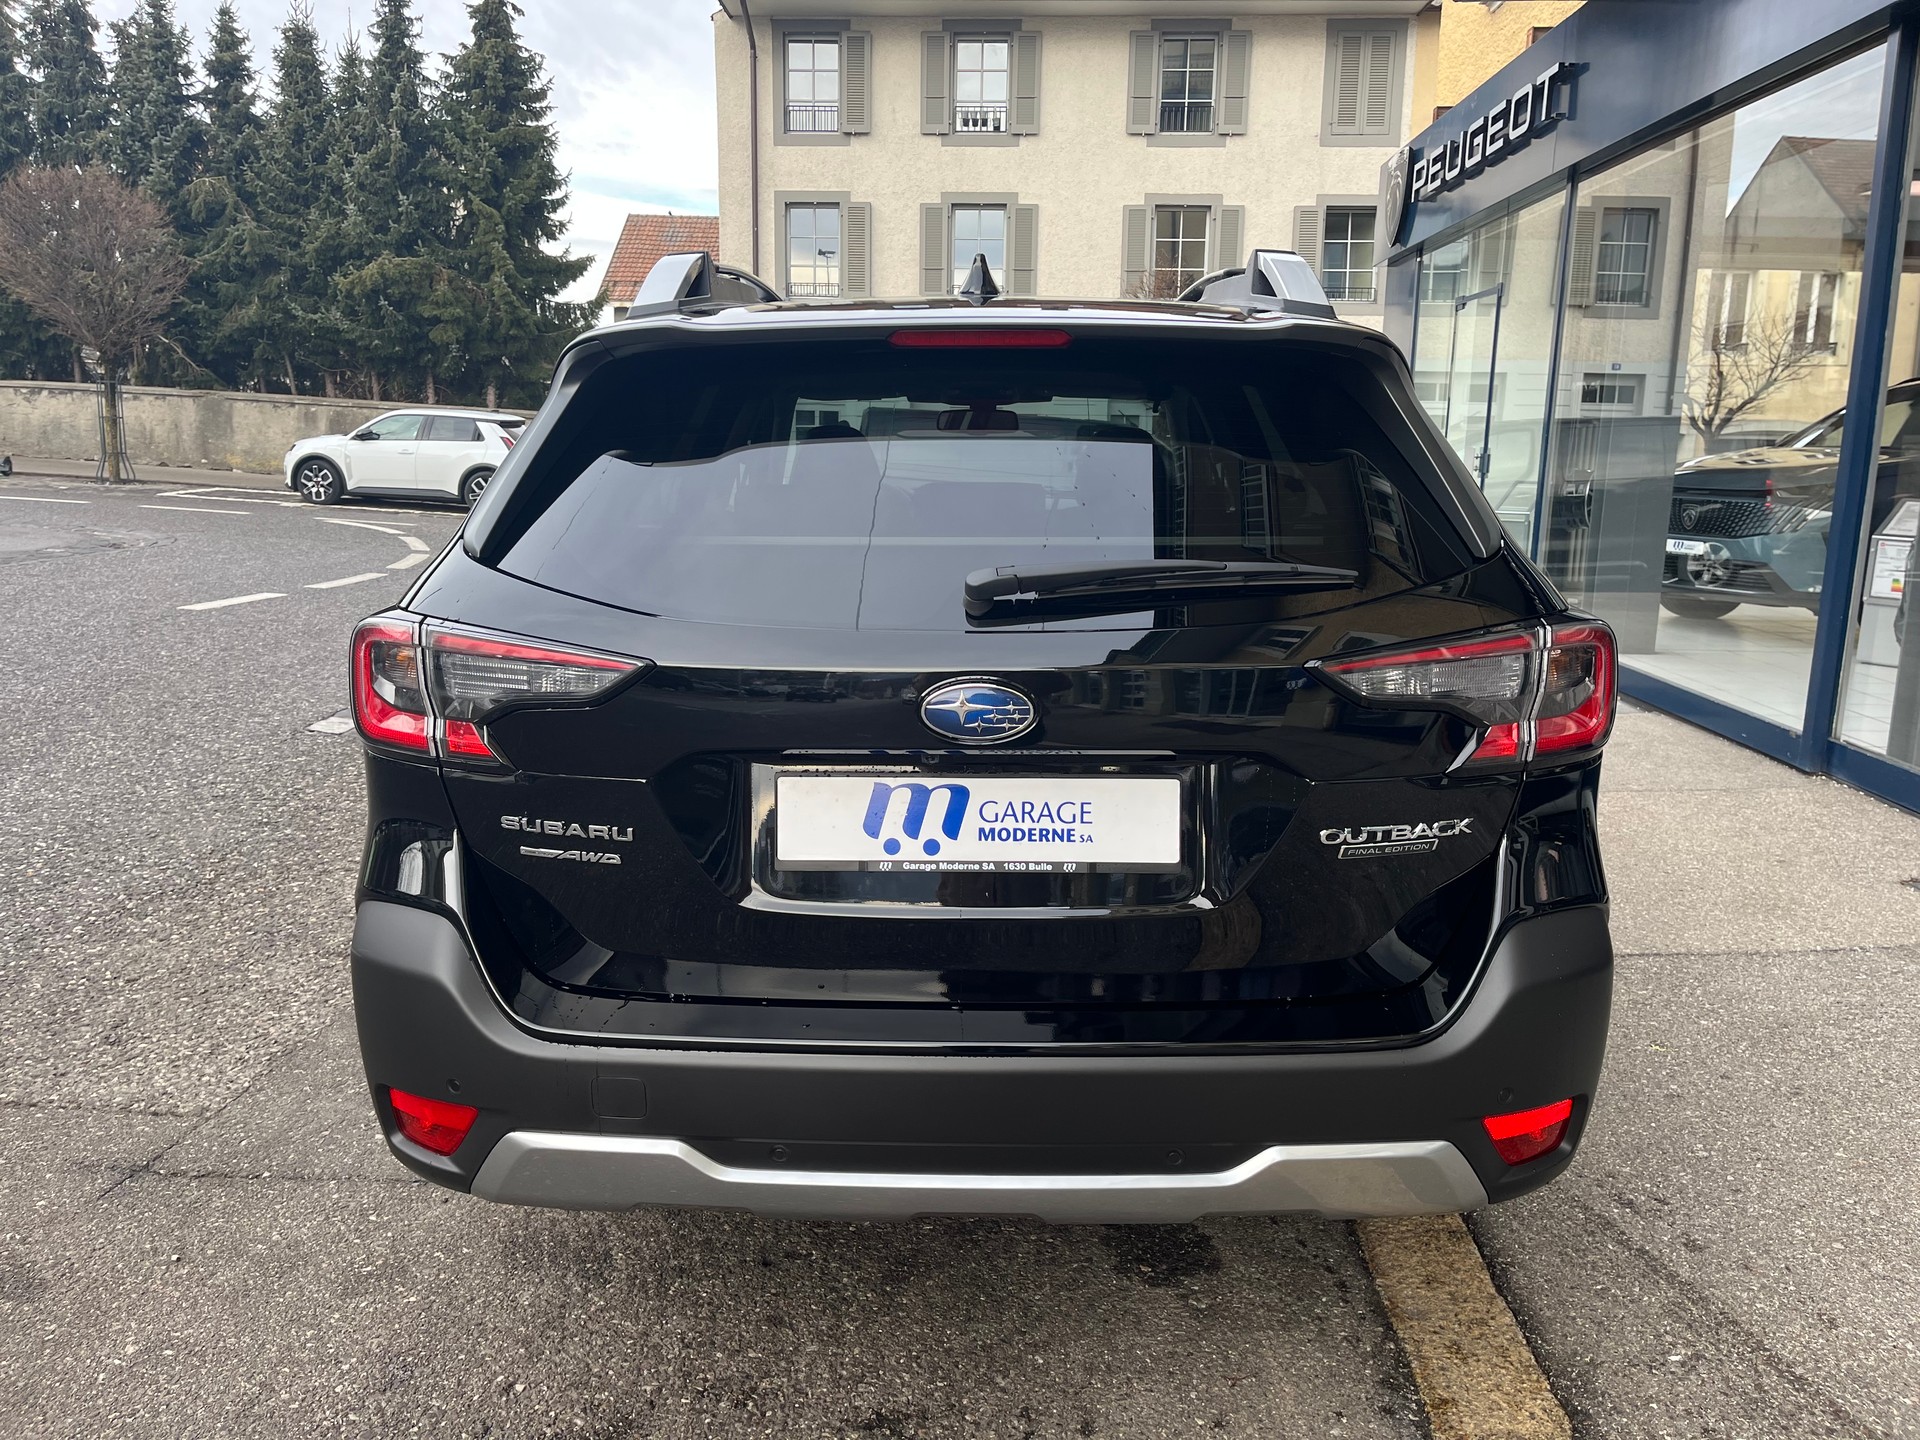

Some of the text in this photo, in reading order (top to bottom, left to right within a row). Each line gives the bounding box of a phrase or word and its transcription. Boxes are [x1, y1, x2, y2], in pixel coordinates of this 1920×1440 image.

[1411, 62, 1560, 203] PEUGEOT
[978, 800, 1093, 824] GARAGE
[500, 815, 634, 842] SUBARU
[978, 827, 1094, 843] MODERNE SA
[1319, 818, 1474, 845] OUTBACK
[557, 850, 622, 865] AWD
[1384, 843, 1430, 853] EDITION
[902, 862, 937, 871] Garage
[938, 862, 980, 870] Moderne
[982, 862, 996, 871] SA
[1003, 862, 1026, 871] 1630
[1028, 862, 1053, 871] Bulle
